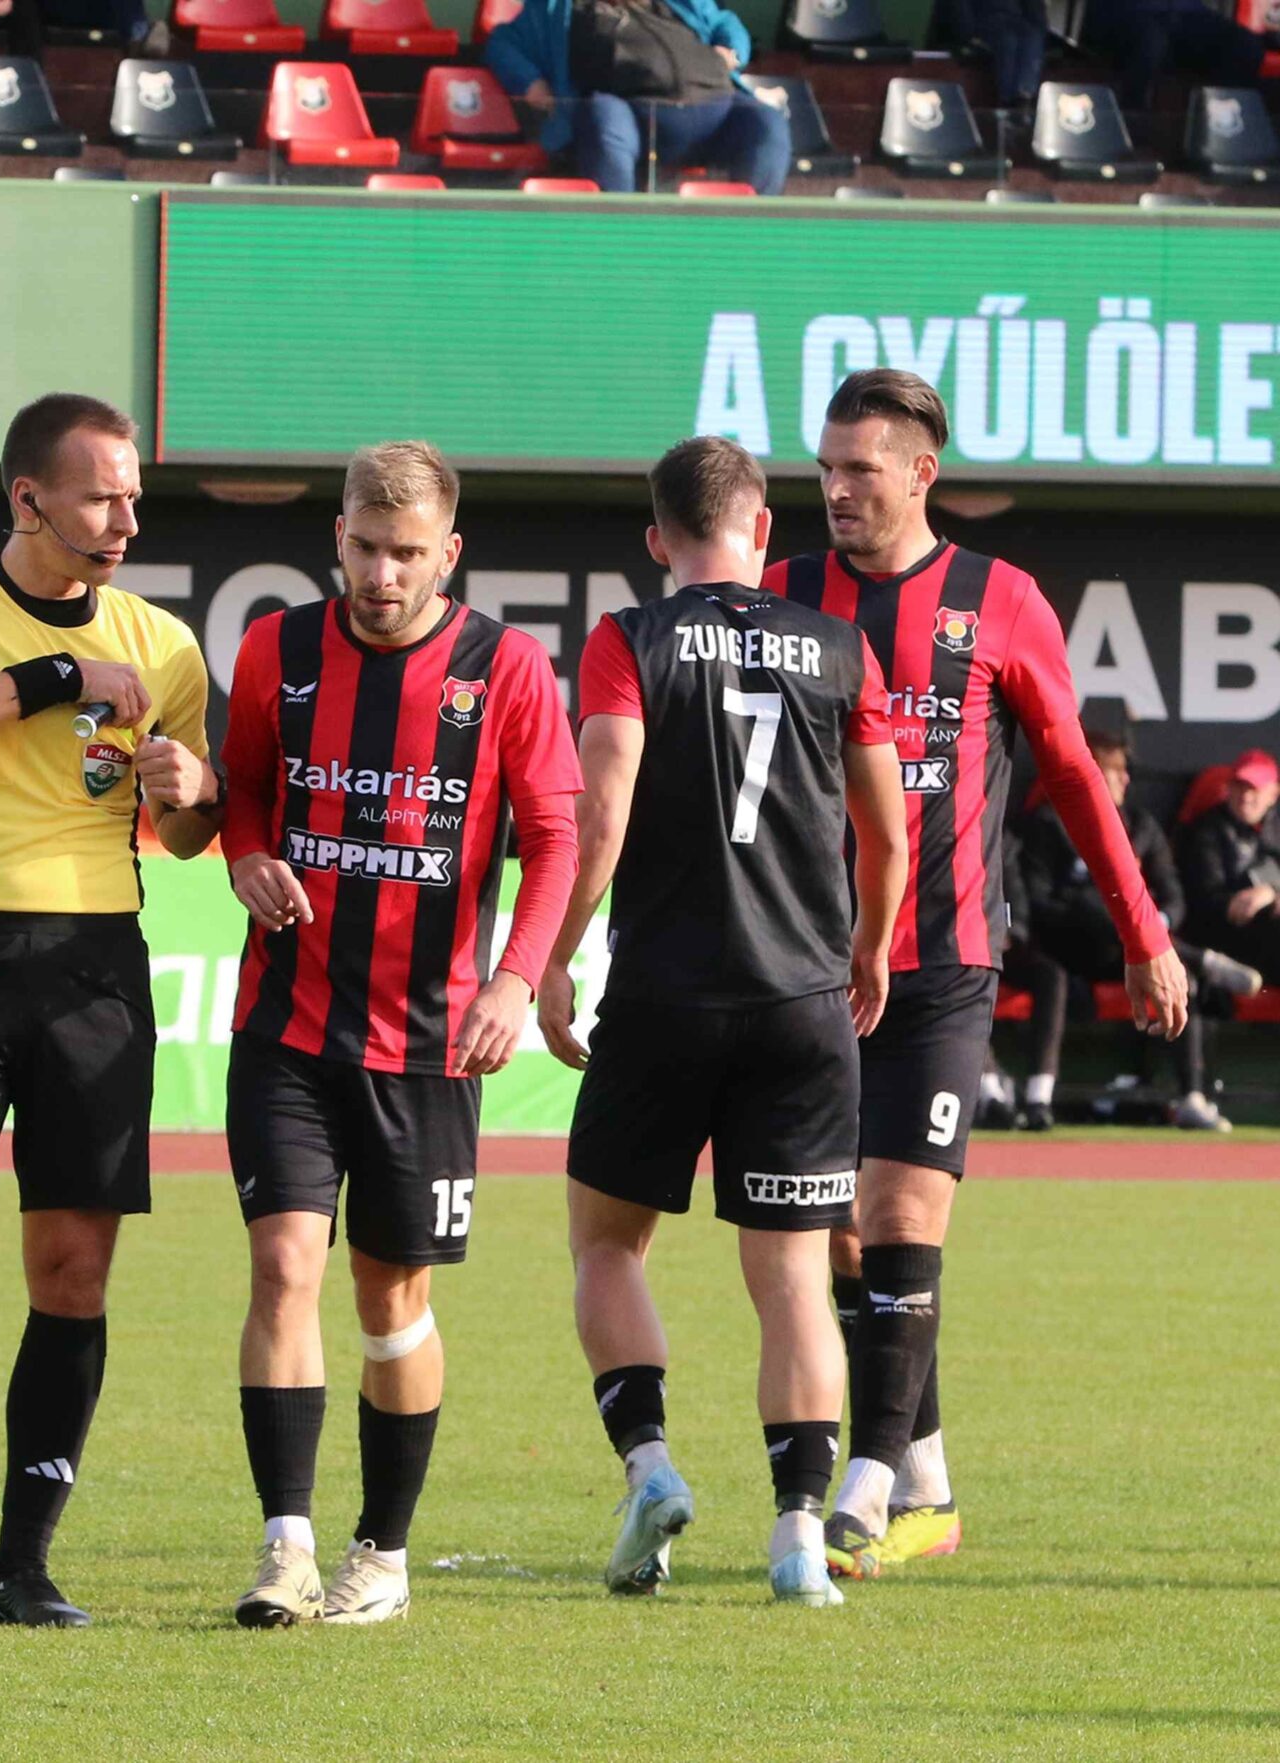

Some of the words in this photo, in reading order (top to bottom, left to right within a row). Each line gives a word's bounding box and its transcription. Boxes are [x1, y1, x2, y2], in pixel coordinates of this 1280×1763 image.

[695, 312, 772, 458] A
[801, 294, 1280, 466] GYŰLÖLE
[675, 624, 820, 677] ZUIGEBER
[285, 757, 468, 803] Zakariás
[723, 687, 782, 844] 7
[358, 806, 463, 830] ALAPÍTVÁNY
[927, 1088, 961, 1147] 9
[432, 1178, 474, 1237] 15
